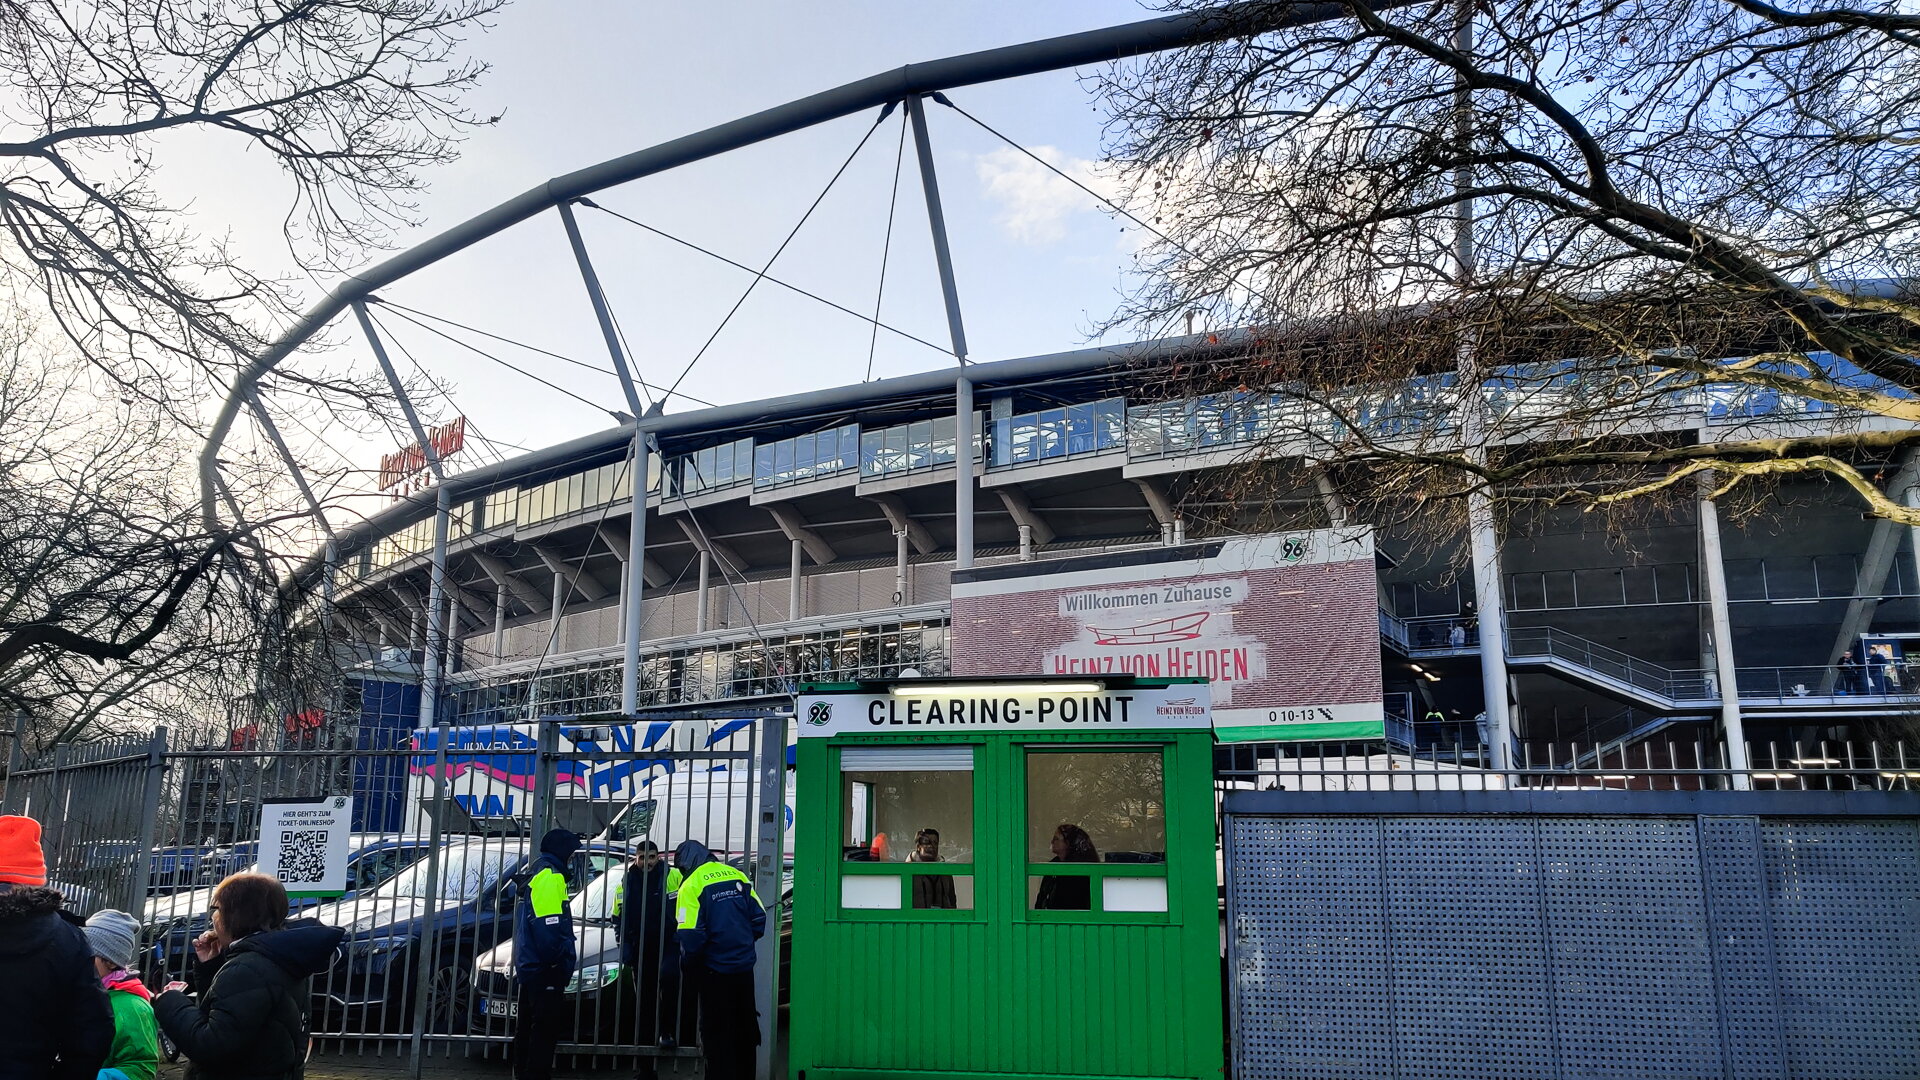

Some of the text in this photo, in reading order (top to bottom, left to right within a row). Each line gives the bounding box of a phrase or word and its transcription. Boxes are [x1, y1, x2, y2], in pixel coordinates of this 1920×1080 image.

[1065, 585, 1232, 612] Willkommen Zuhause
[1120, 653, 1160, 677] VON
[1167, 647, 1249, 682] HEIDEN
[808, 703, 832, 724] 96
[868, 697, 1134, 726] CLEARING-POINT
[1156, 706, 1173, 716] HEINZ
[1281, 709, 1315, 721] 10-13
[333, 797, 347, 809] 96
[277, 819, 336, 827] TICKET-ONLINESHOP
